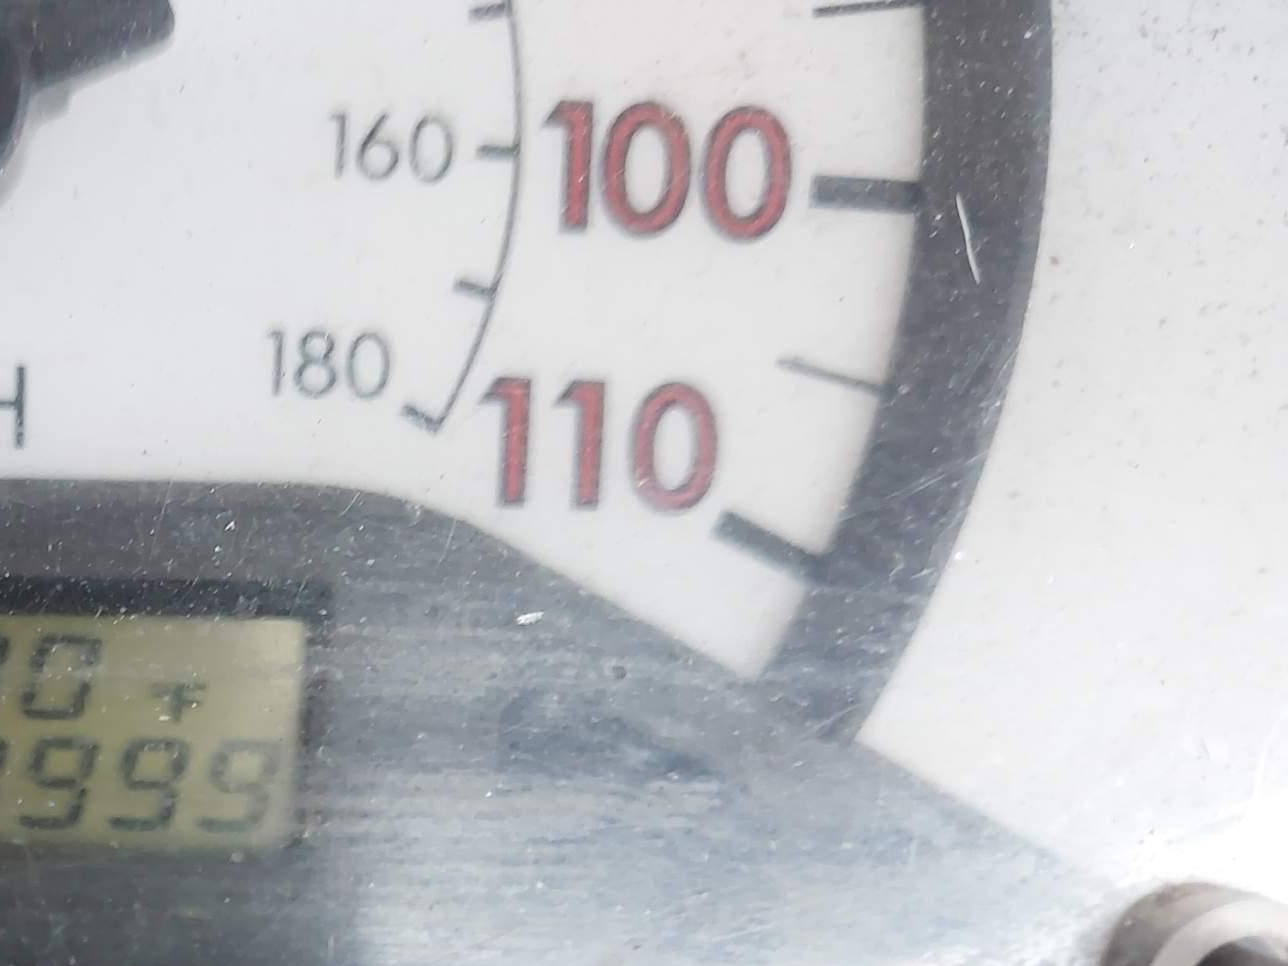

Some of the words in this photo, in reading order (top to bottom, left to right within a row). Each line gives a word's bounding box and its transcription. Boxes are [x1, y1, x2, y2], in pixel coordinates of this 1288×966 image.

[331, 110, 453, 184] 160
[544, 99, 792, 241] 100
[266, 329, 392, 400] 180
[480, 376, 719, 511] 110
